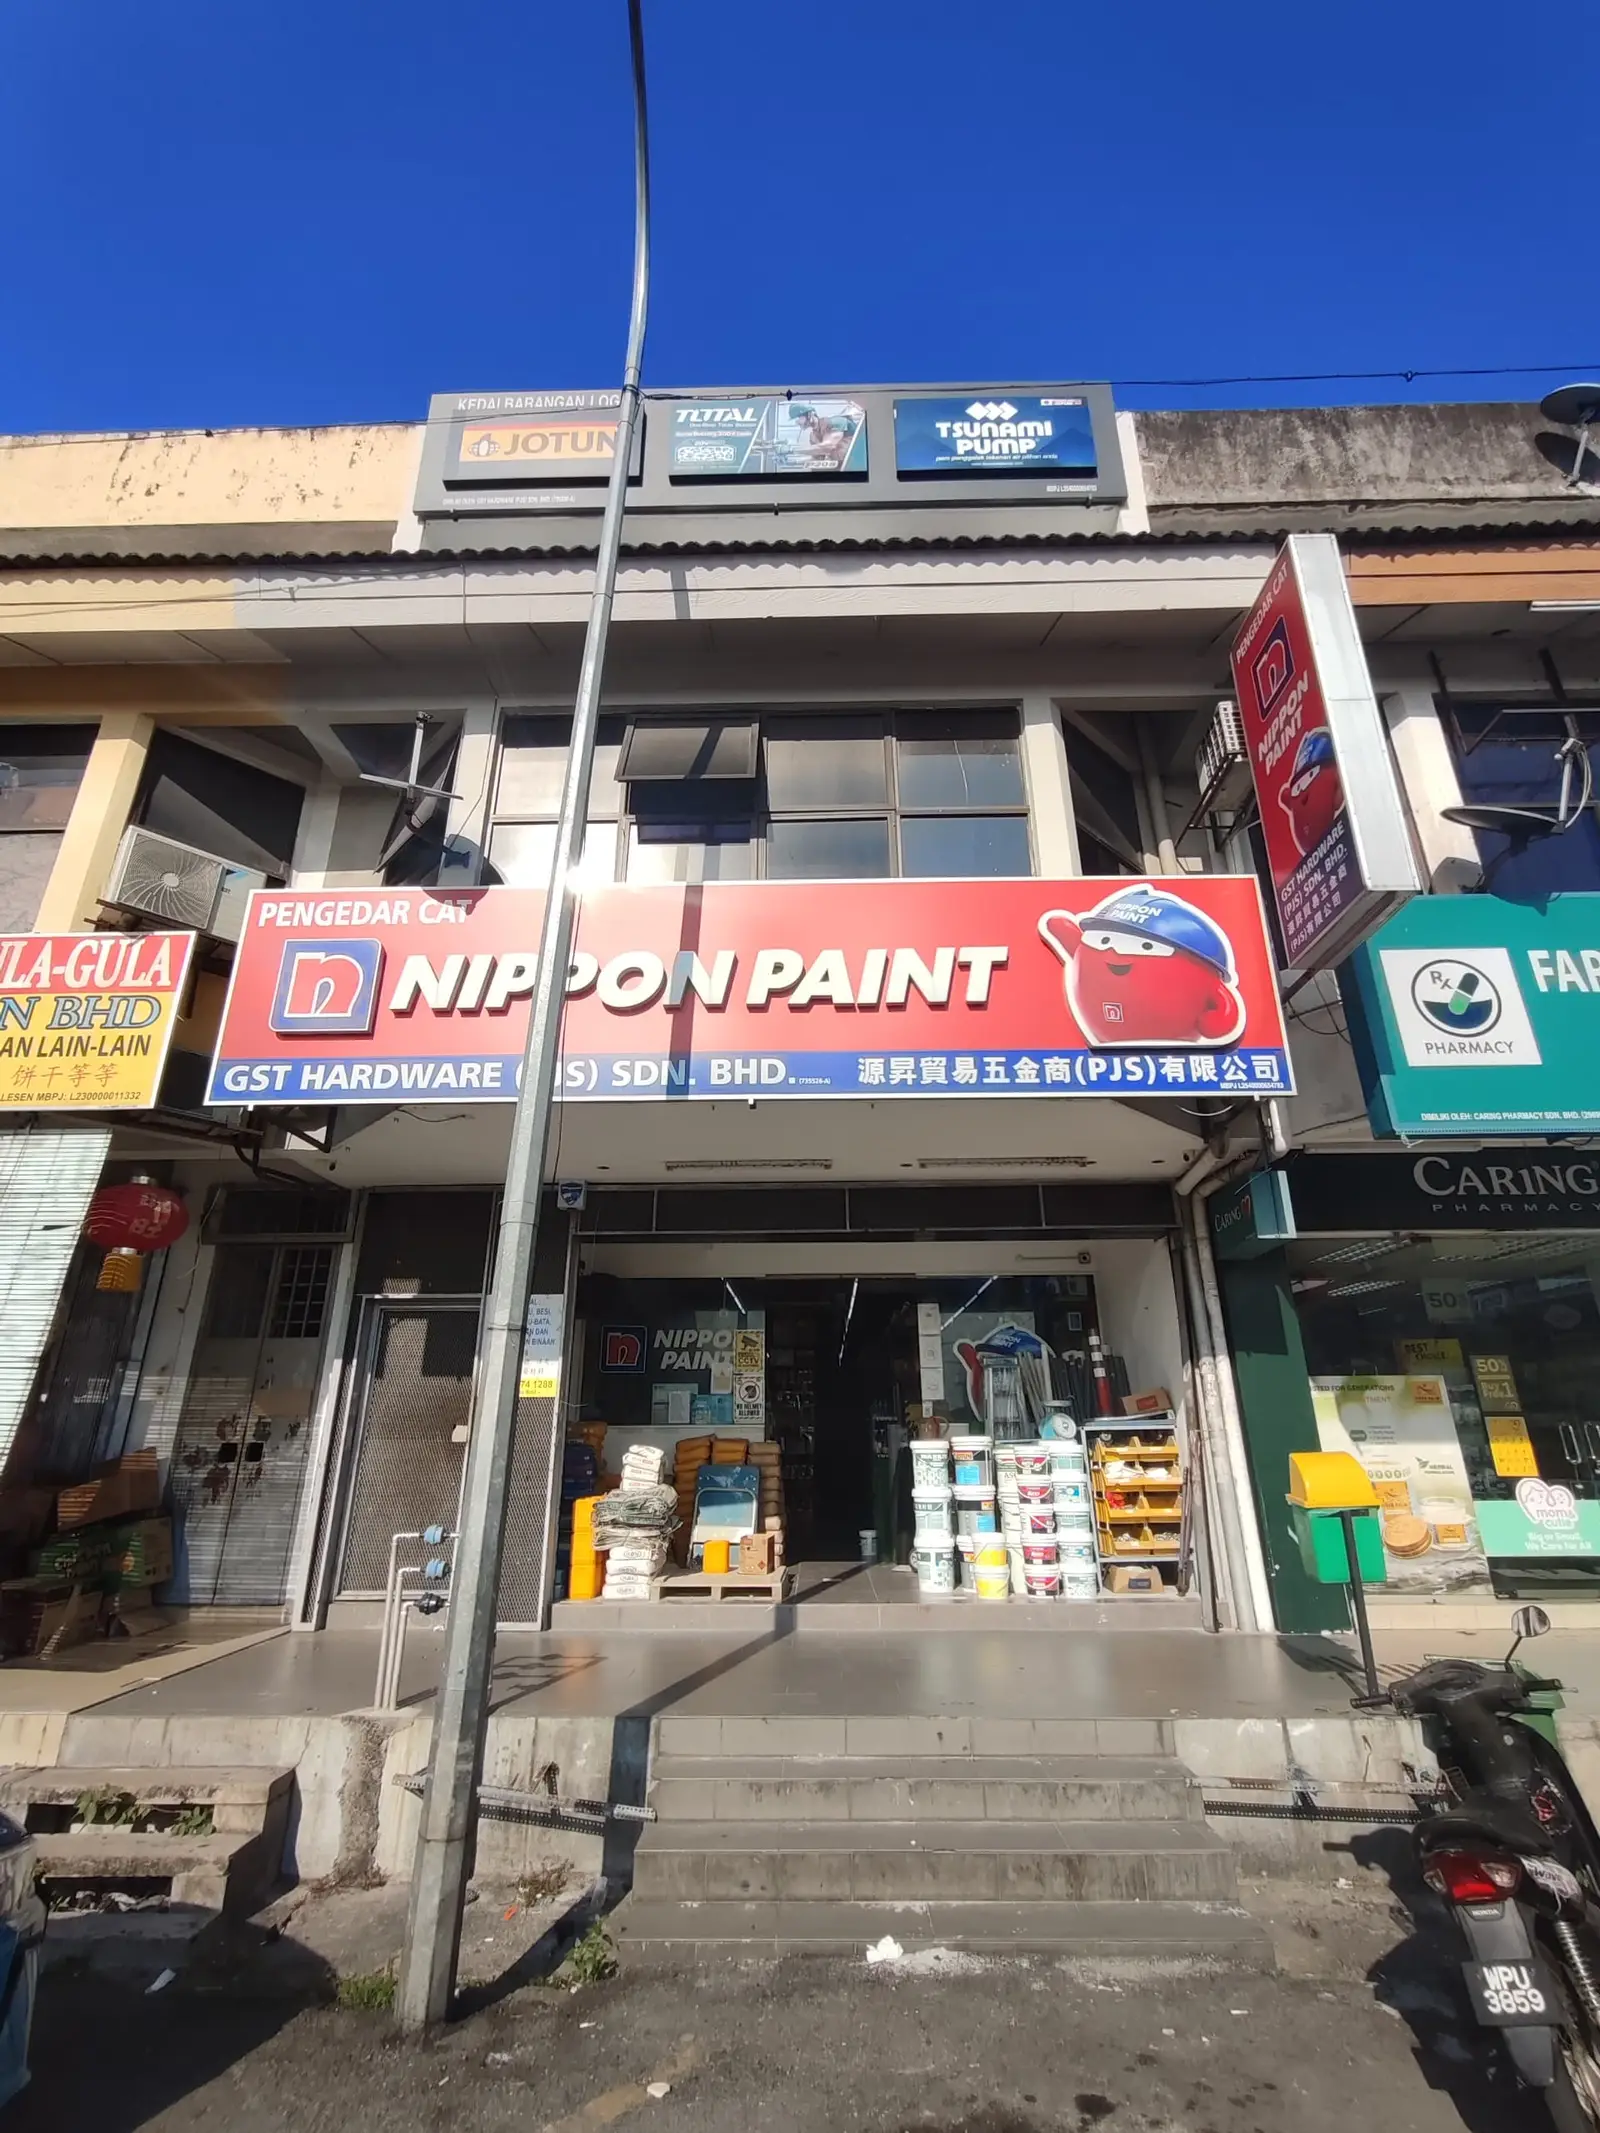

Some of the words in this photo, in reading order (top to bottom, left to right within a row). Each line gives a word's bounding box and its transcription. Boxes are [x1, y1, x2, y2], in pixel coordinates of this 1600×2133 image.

[458, 399, 500, 411] KEDAI
[504, 395, 585, 409] BARANGAN
[590, 394, 620, 407] LOG
[676, 408, 758, 422] TOTAL
[935, 420, 1054, 438] TSUNAMI
[504, 431, 618, 456] JOTUN
[956, 438, 1037, 455] PUMP
[1235, 592, 1273, 665] PENGEDAR
[1272, 561, 1288, 595] CAT
[1258, 669, 1309, 763] NIPPON
[1265, 704, 1303, 776] PAINT
[1281, 876, 1296, 902] GST
[1295, 820, 1345, 885] HARDWARE
[1284, 889, 1303, 921] (PJS)
[1303, 868, 1325, 897] SDN.
[1324, 843, 1348, 873] BHD.
[258, 900, 411, 928] PENGEDAR
[418, 900, 471, 925] CAT
[1110, 909, 1150, 924] PAINT
[1112, 903, 1163, 917] NIPPON
[746, 946, 1009, 1009] PAINT
[46, 995, 162, 1031] BHD
[36, 1035, 152, 1058] LAIN-LAIN
[1424, 1040, 1514, 1055] PHARMACY
[10, 1062, 119, 1089] 饼干等等
[223, 1065, 292, 1092] GST
[299, 1061, 504, 1090] HARDWARE
[515, 1058, 599, 1092] (JS)
[611, 1059, 696, 1087] SDN.
[710, 1057, 796, 1086] BHD.
[1, 1092, 35, 1102] LESEN
[1474, 1112, 1502, 1120] CARING
[1502, 1111, 1544, 1120] PHARMACY
[1413, 1156, 1599, 1197] CARING
[1432, 1203, 1600, 1213] PHARMACY
[653, 1329, 732, 1349] NIPPO
[1472, 1908, 1500, 1916] HONDA
[1482, 1966, 1531, 1991] WPU
[1483, 1987, 1546, 2014] 3859
